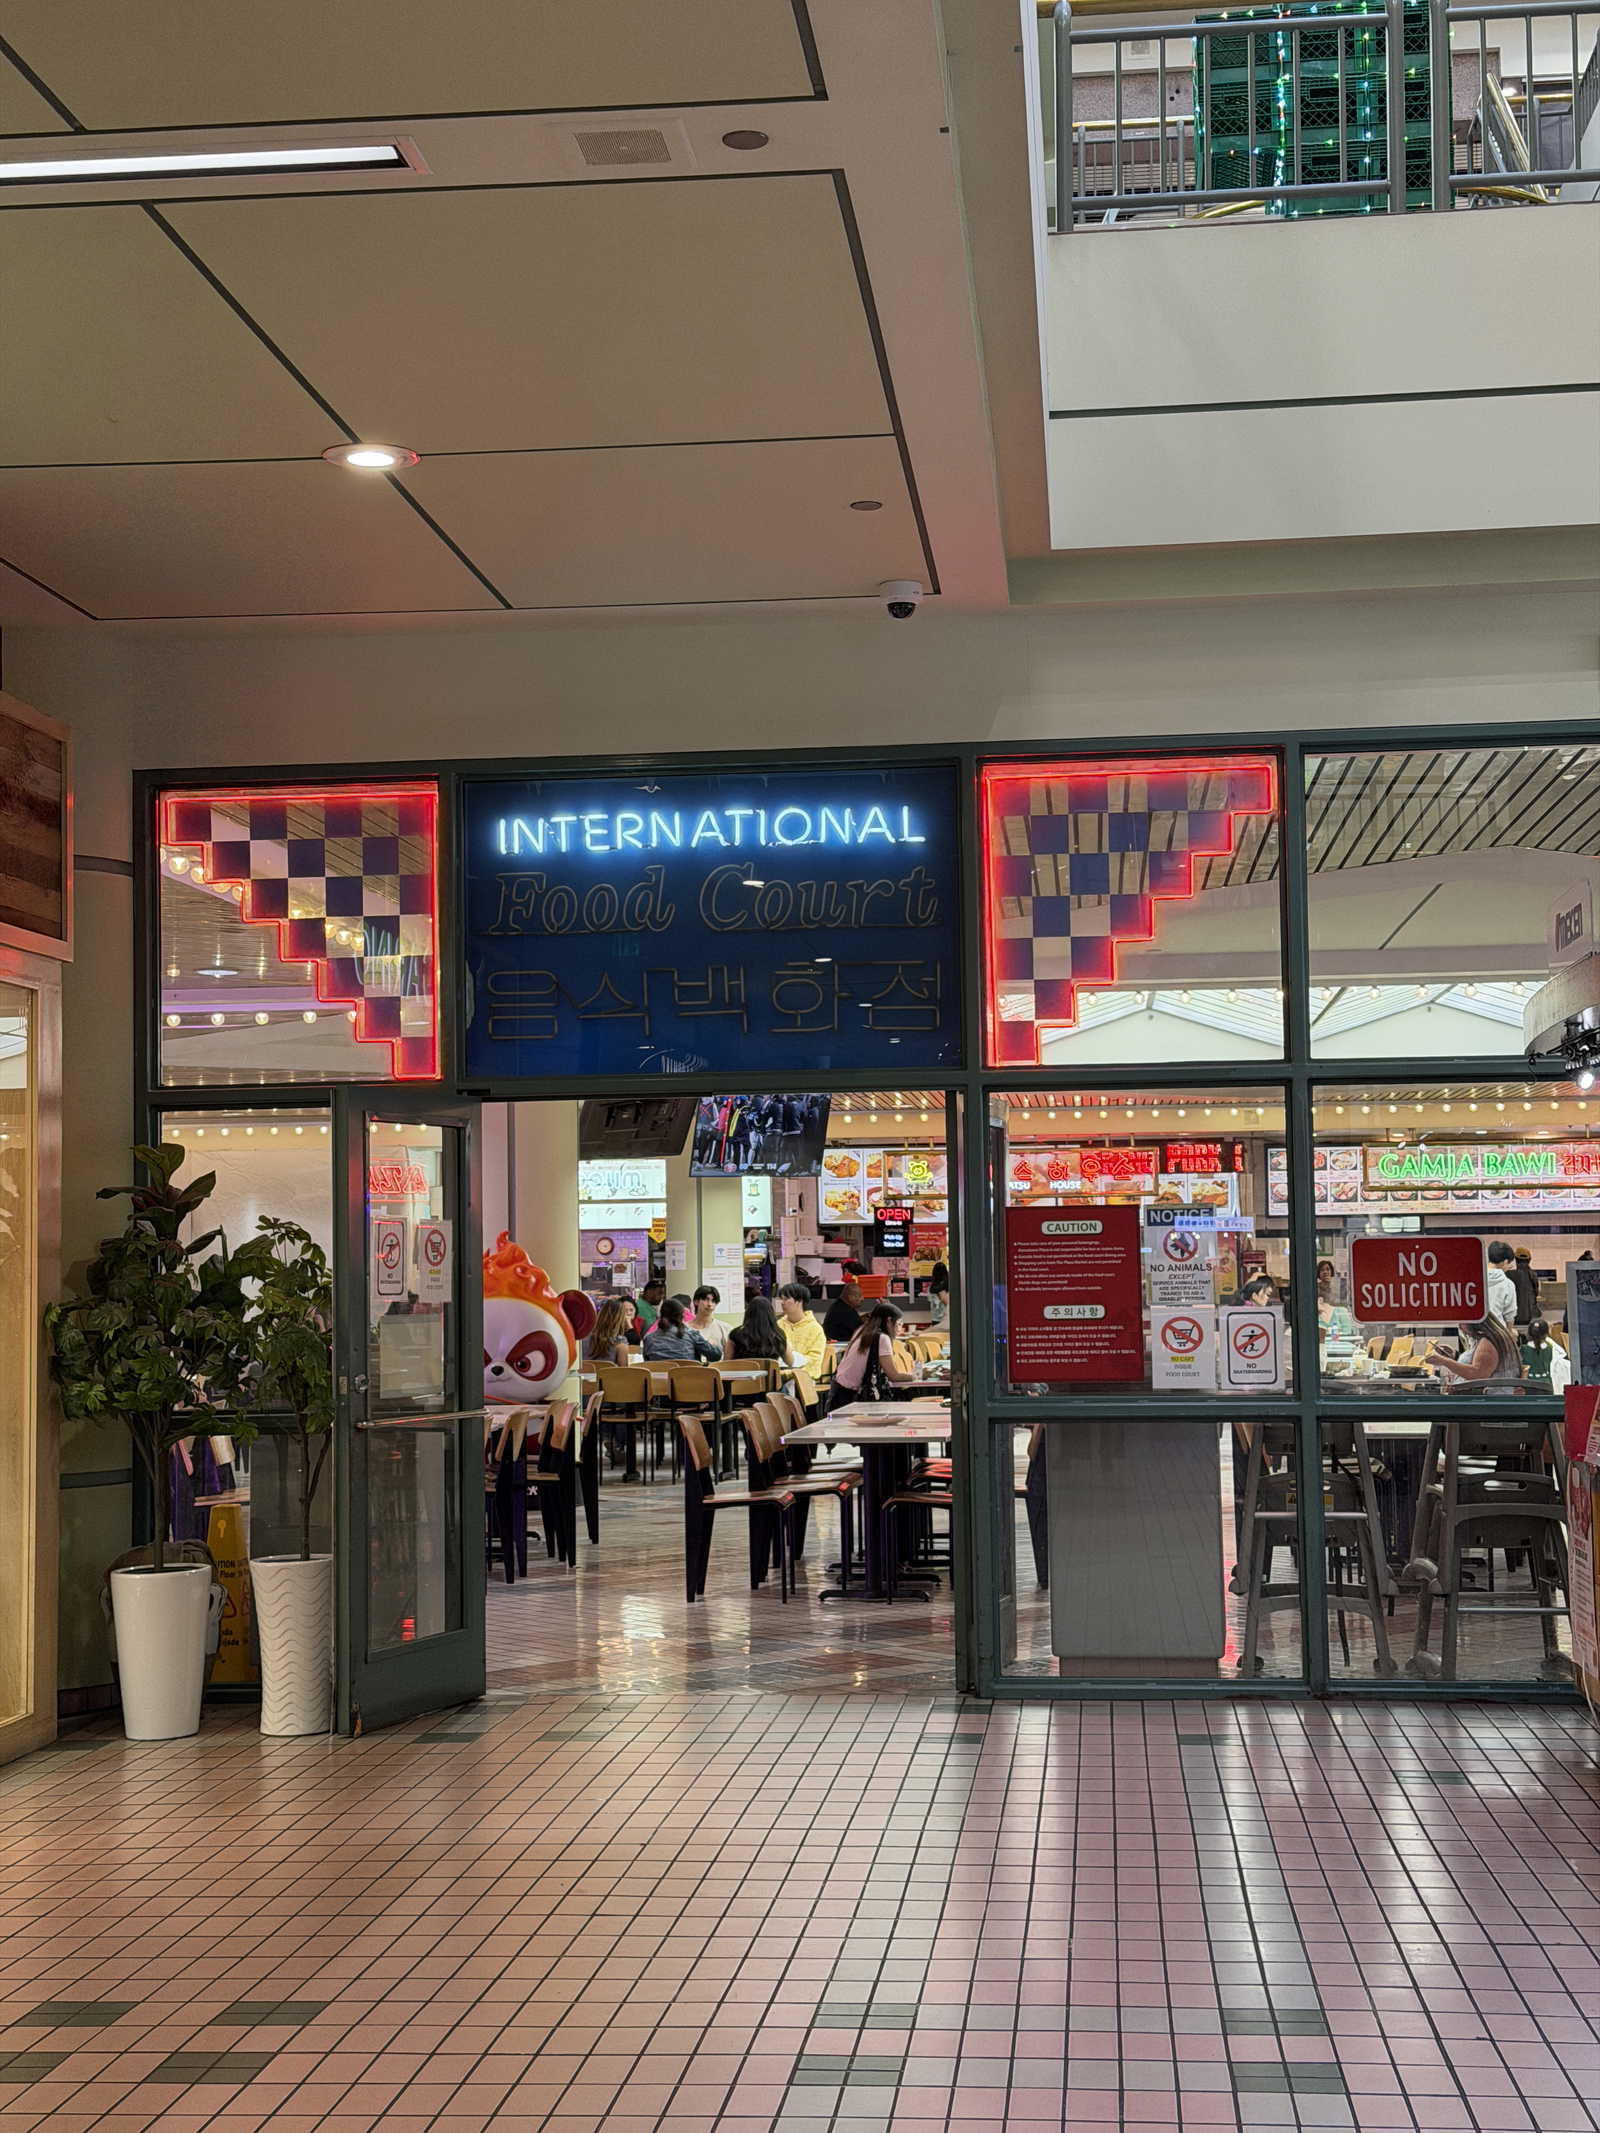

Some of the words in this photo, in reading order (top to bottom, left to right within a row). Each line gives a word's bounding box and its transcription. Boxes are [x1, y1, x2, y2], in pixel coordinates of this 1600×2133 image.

[498, 805, 926, 854] INTERNATIONAL
[488, 865, 676, 935] Food
[700, 862, 938, 931] Court
[487, 960, 941, 1040] 음식백화점
[1378, 1152, 1476, 1181] GAMJA
[1484, 1152, 1557, 1177] BAWI
[1050, 1181, 1081, 1189] HOUSE
[876, 1208, 911, 1220] OPEN
[1046, 1222, 1098, 1233] CAUTION
[1150, 1264, 1165, 1273] NO
[1167, 1263, 1213, 1272] ANIMALS
[1397, 1251, 1438, 1277] NO
[1360, 1281, 1478, 1309] SOLICITING
[1051, 1306, 1099, 1318] 주의사항
